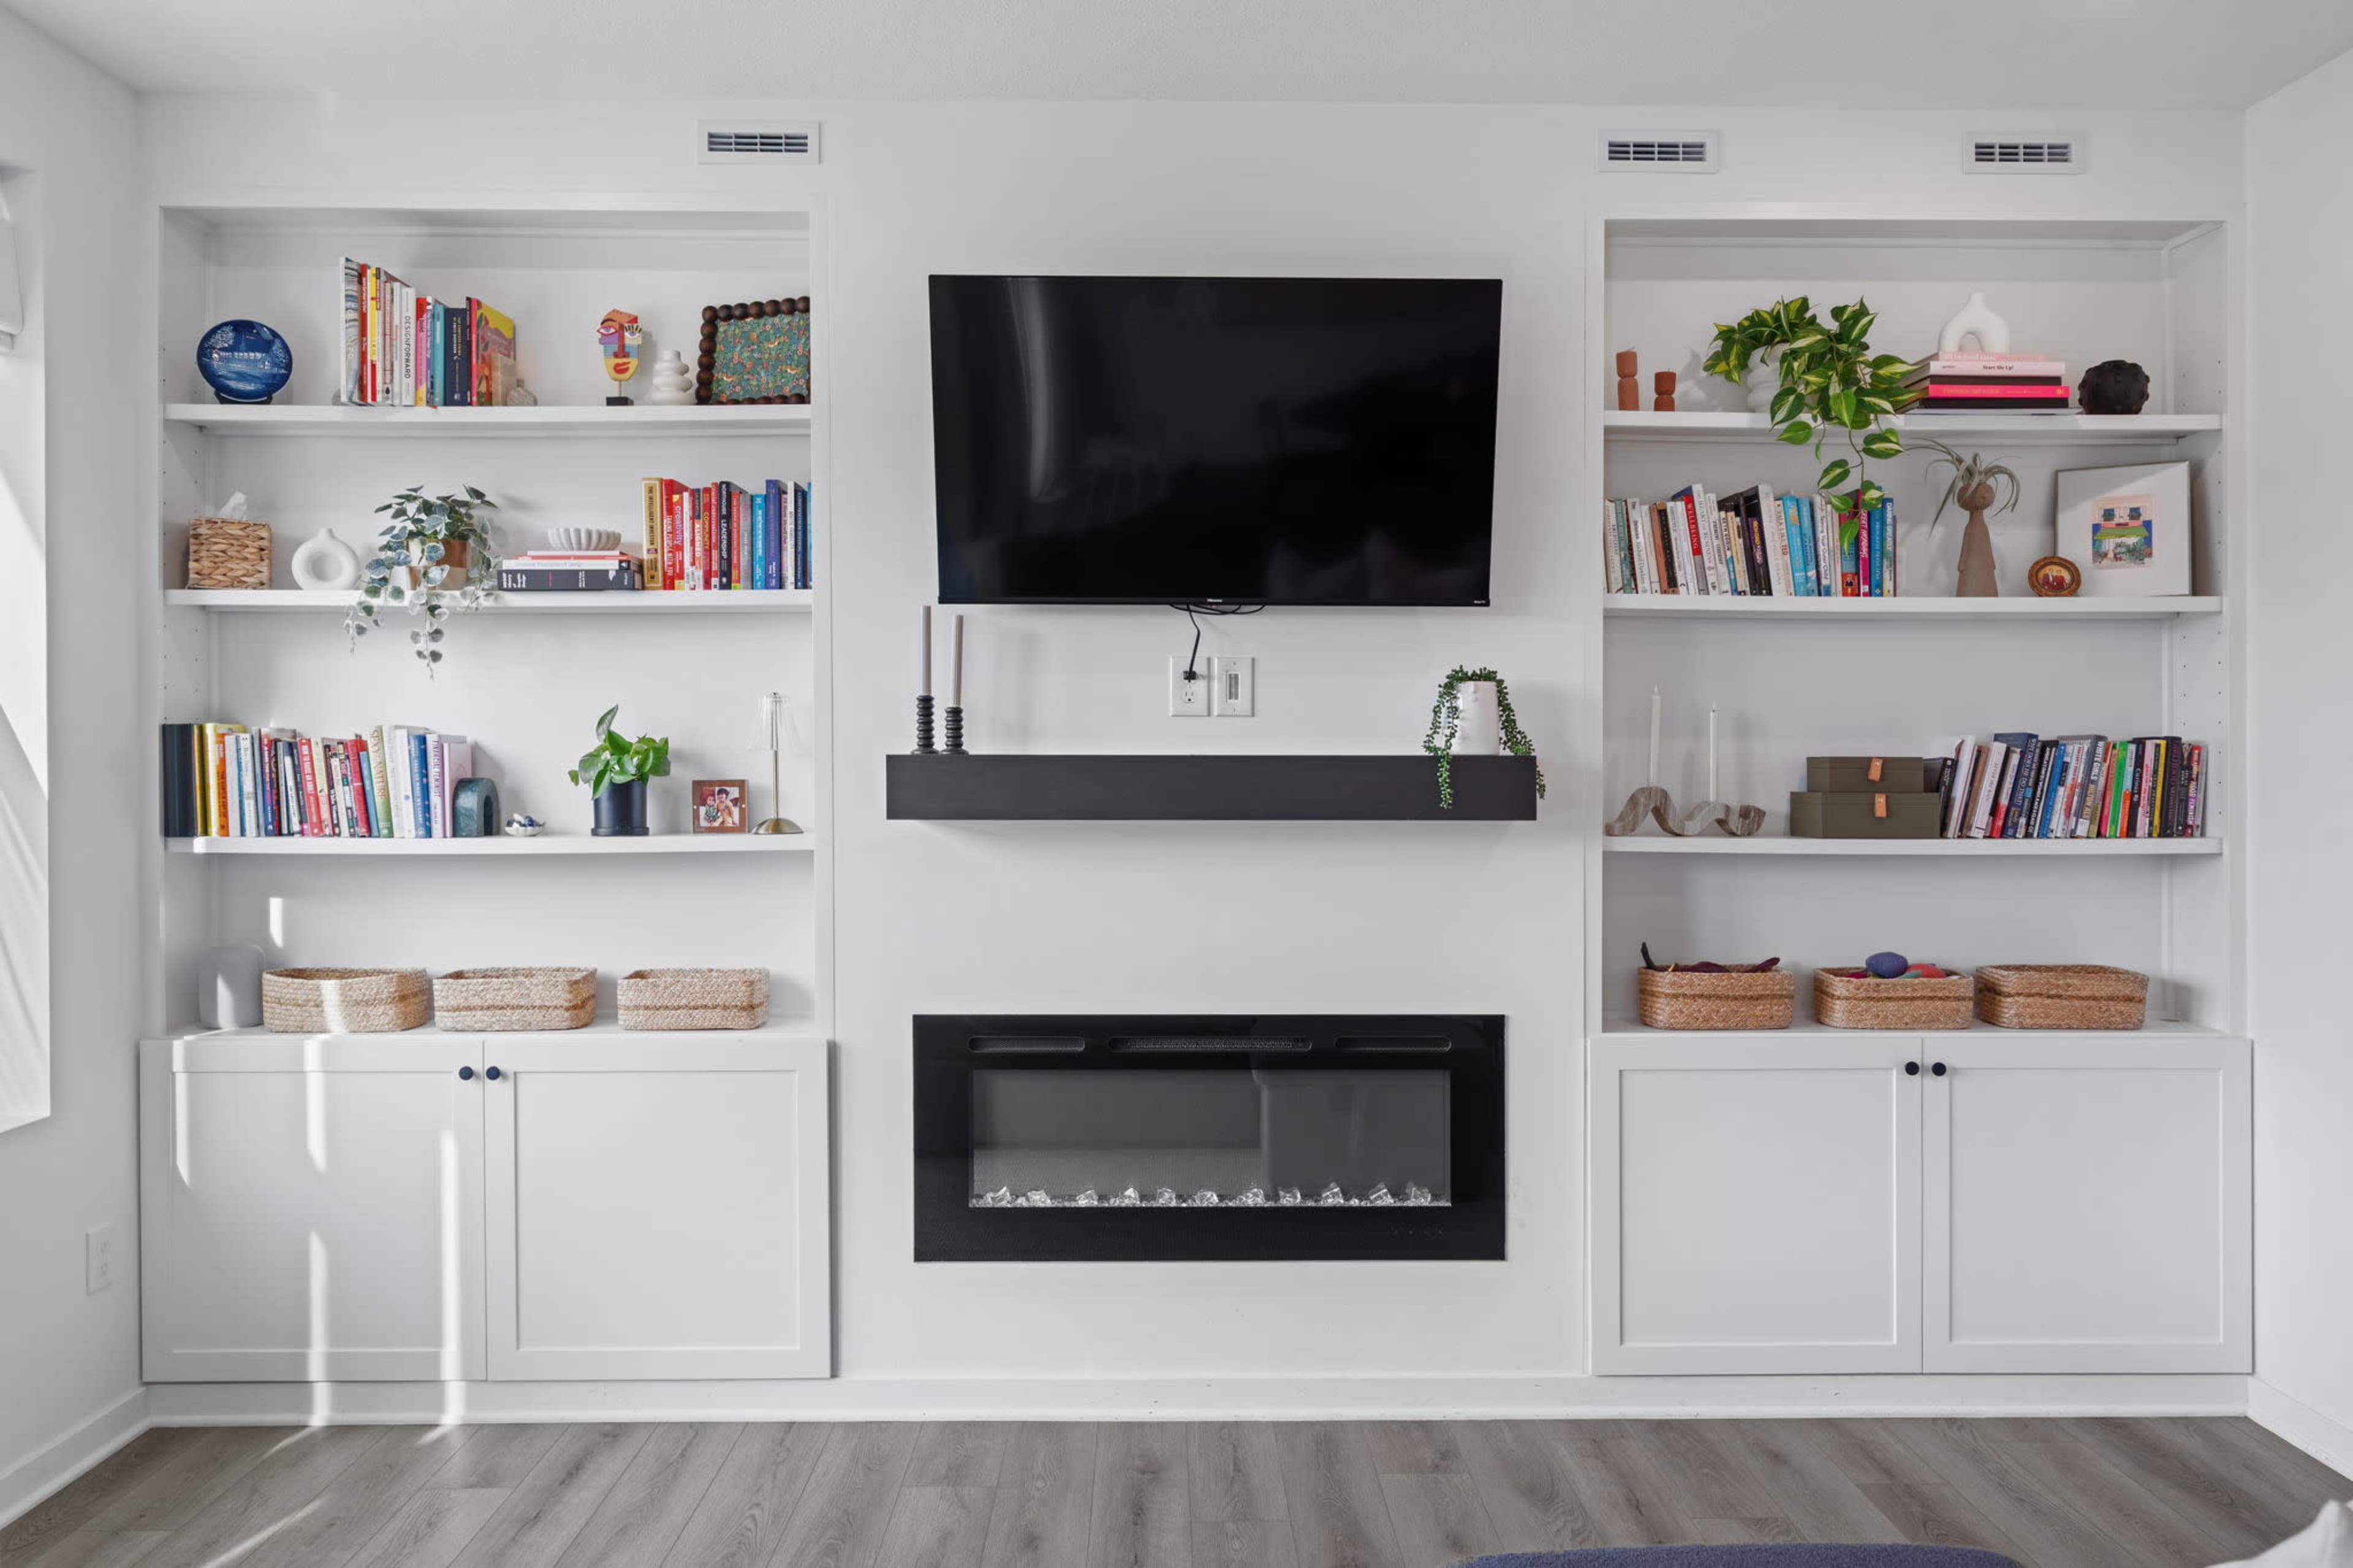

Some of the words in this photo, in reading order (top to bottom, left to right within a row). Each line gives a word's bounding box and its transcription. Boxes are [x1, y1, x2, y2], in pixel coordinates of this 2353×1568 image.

[674, 506, 683, 545] creativity
[1687, 503, 1699, 549] WELLBEING
[433, 740, 441, 769] FINANCIAL
[2094, 741, 2105, 761] WHITE
[369, 730, 380, 753] SEXY
[376, 761, 386, 800] NATURE
[2091, 762, 2101, 781] GIRLS
[2085, 784, 2096, 805] HILTON
[2083, 808, 2091, 819] ALS
[2186, 798, 2196, 825] FEMINISM
